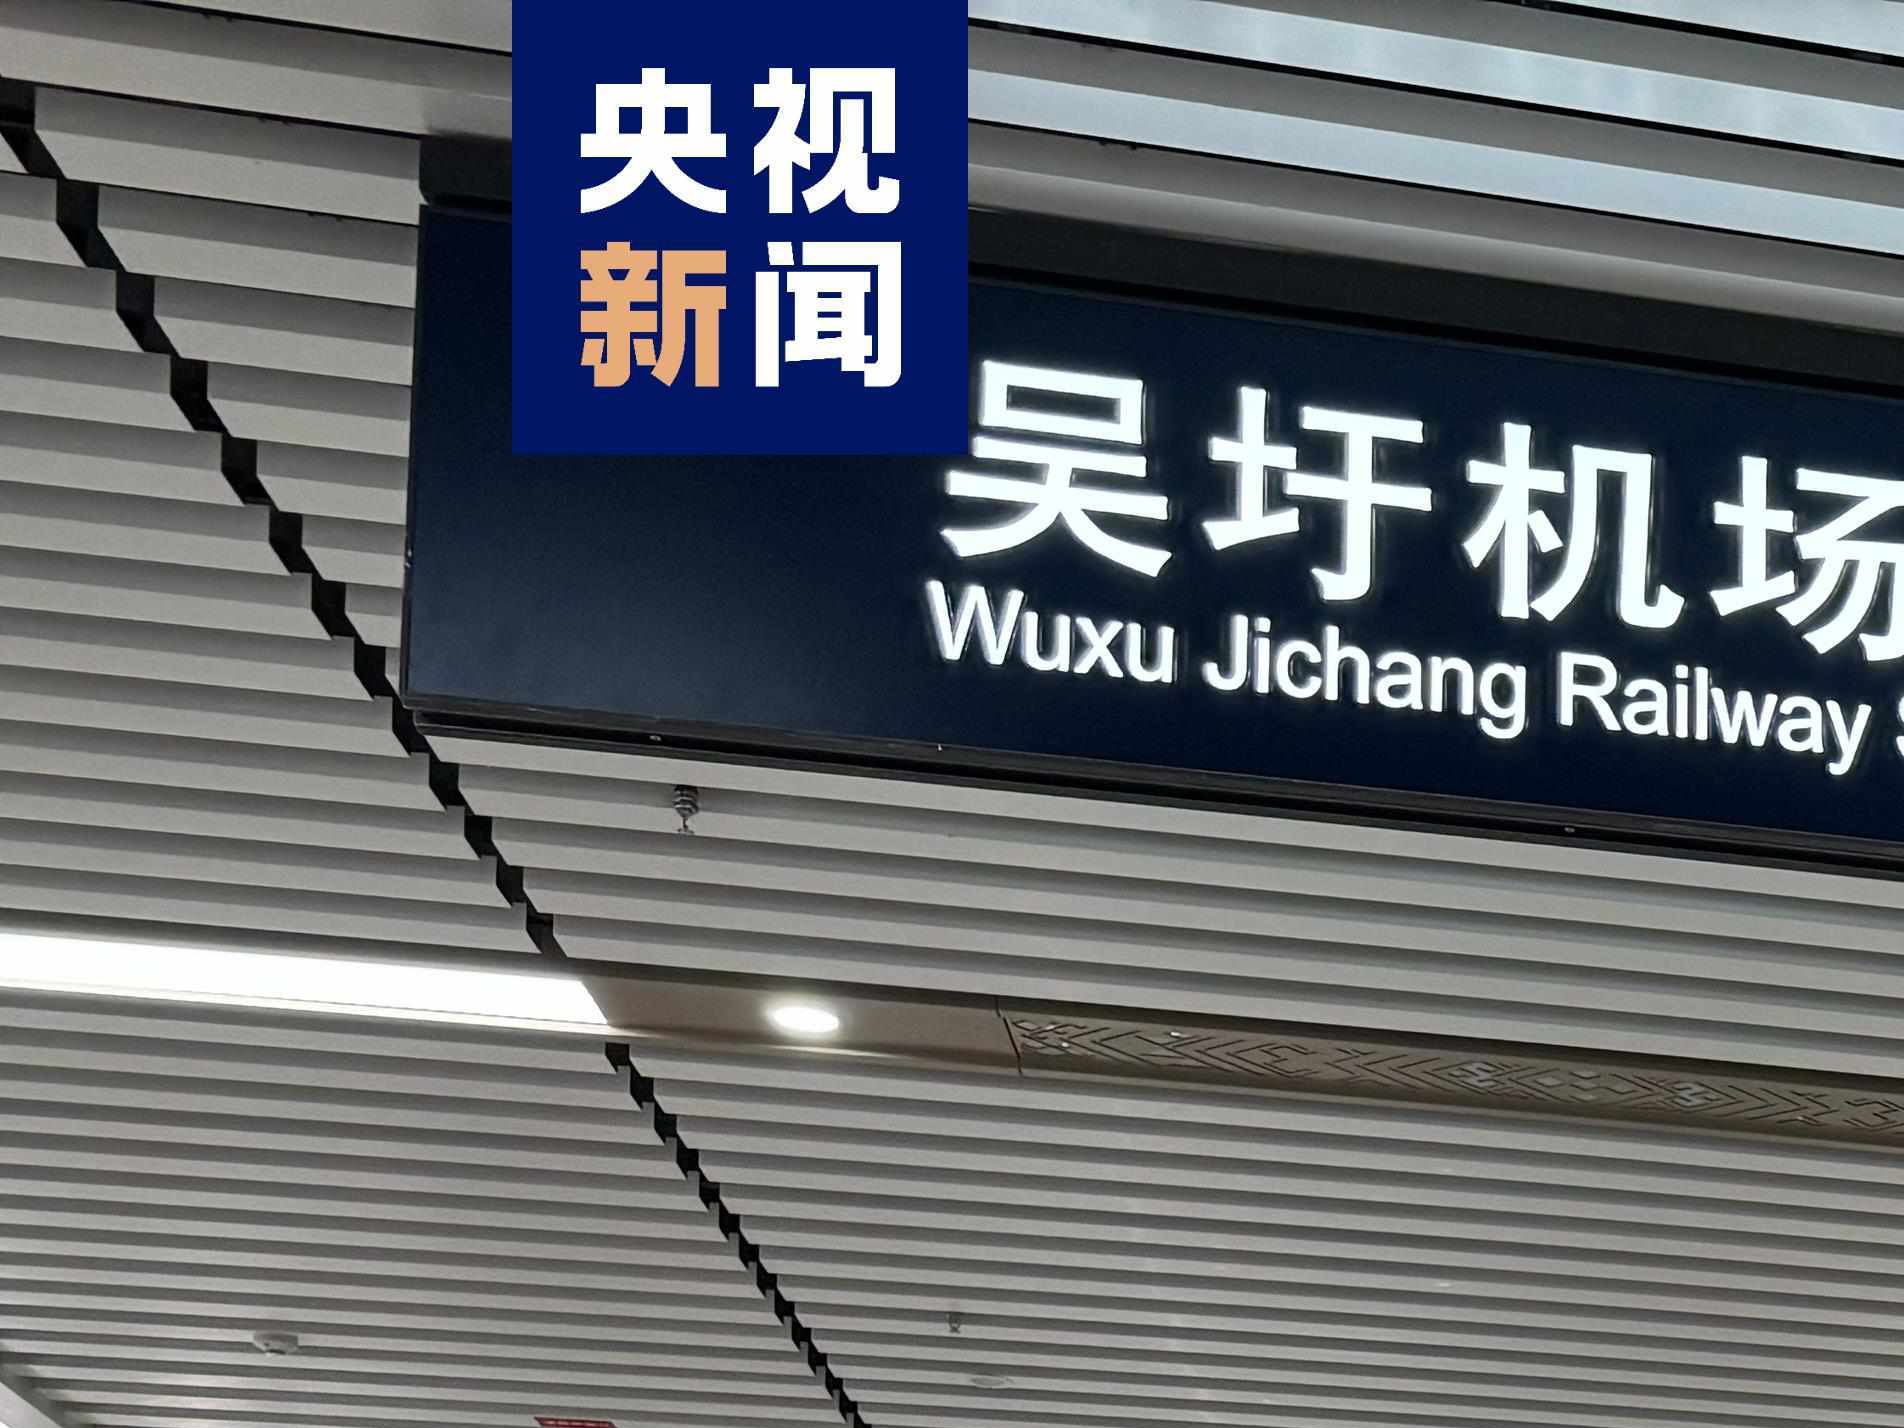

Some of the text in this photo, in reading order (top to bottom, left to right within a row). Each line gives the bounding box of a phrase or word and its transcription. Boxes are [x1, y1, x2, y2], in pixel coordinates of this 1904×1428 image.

[926, 579, 1176, 684] Wuxu
[1202, 613, 1528, 740] Jichang
[1558, 650, 1873, 777] Railway
